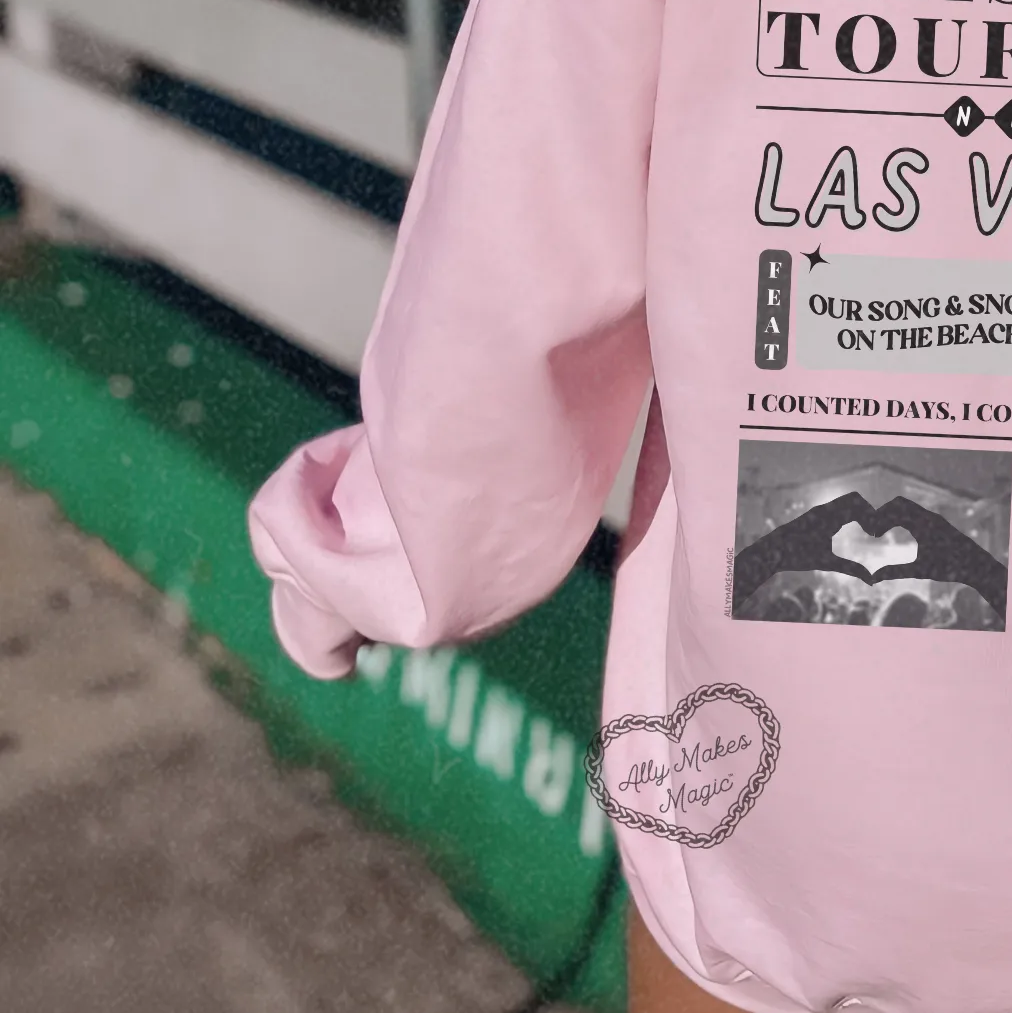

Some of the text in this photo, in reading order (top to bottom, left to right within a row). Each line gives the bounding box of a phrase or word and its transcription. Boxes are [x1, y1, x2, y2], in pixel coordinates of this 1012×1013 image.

[755, 142, 929, 232] LAS
[764, 262, 782, 360] FEAT
[809, 294, 863, 321] OUR
[868, 297, 940, 321] SONG
[945, 296, 964, 316] &
[837, 329, 876, 350] ON
[880, 327, 932, 350] THE
[748, 394, 755, 411] I
[762, 394, 880, 416] COUNTED
[886, 400, 955, 423] DAYS,
[962, 403, 970, 420] I
